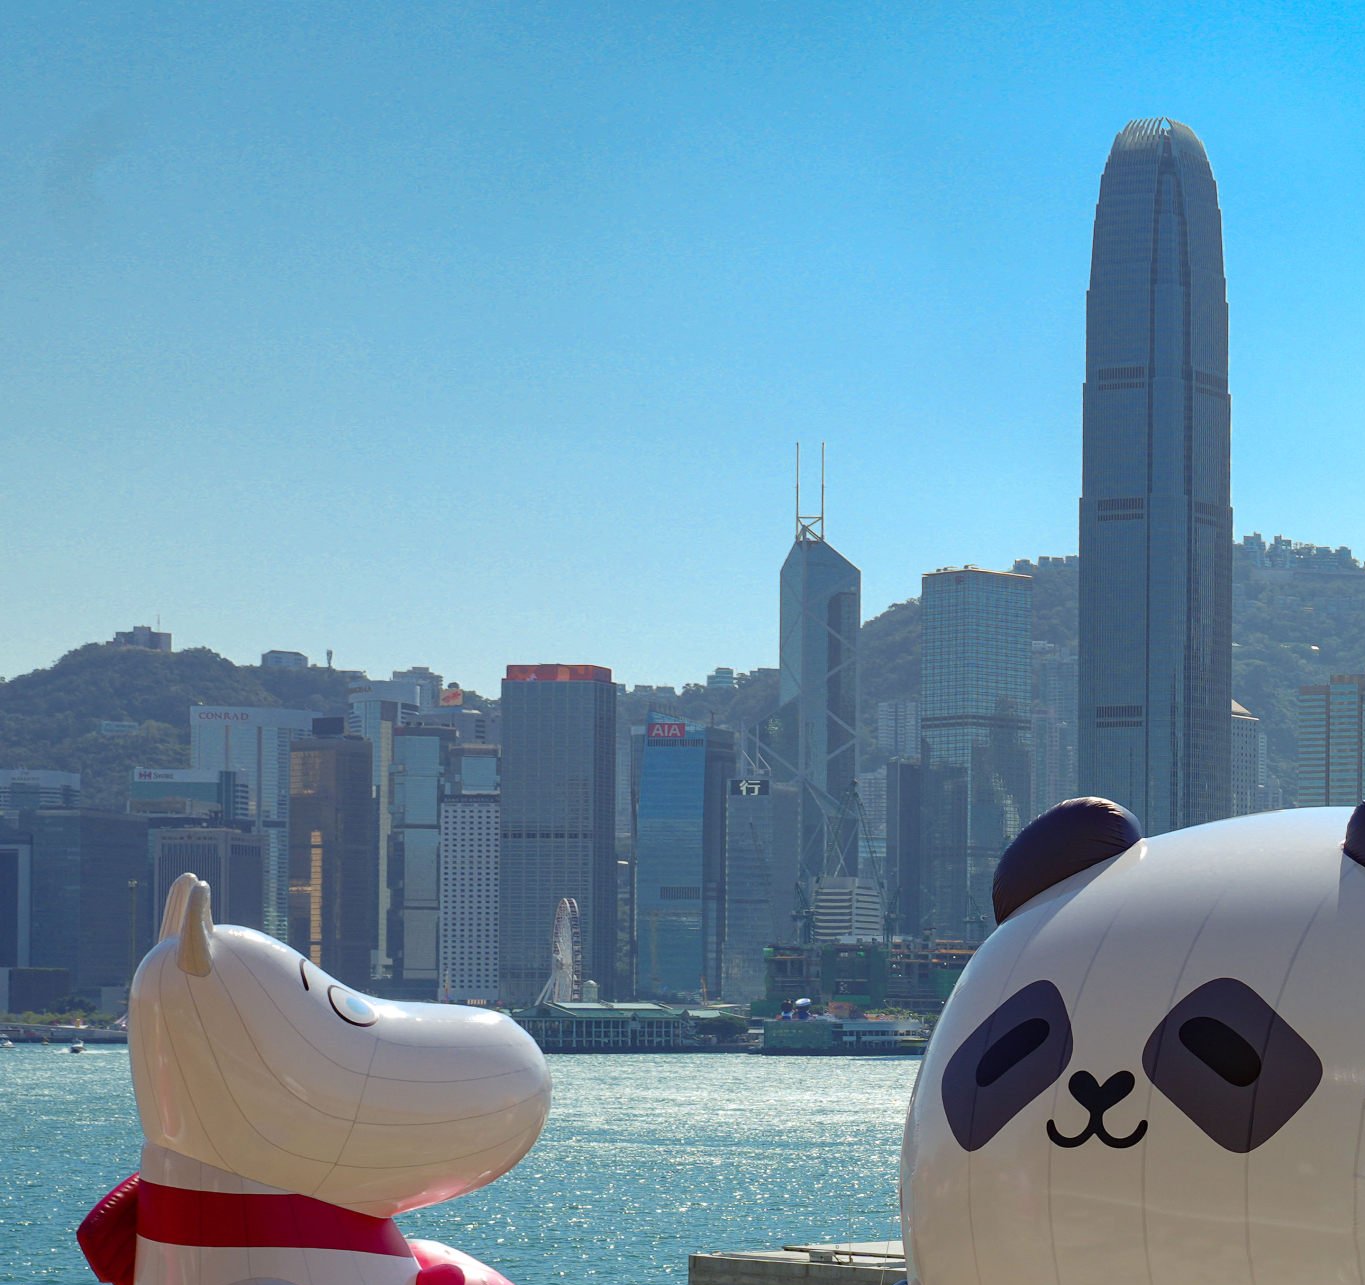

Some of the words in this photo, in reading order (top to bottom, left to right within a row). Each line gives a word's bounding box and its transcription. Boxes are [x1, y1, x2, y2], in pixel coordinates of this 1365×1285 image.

[198, 711, 249, 721] CONRAD
[652, 724, 681, 737] AIA
[739, 780, 761, 796] 行
